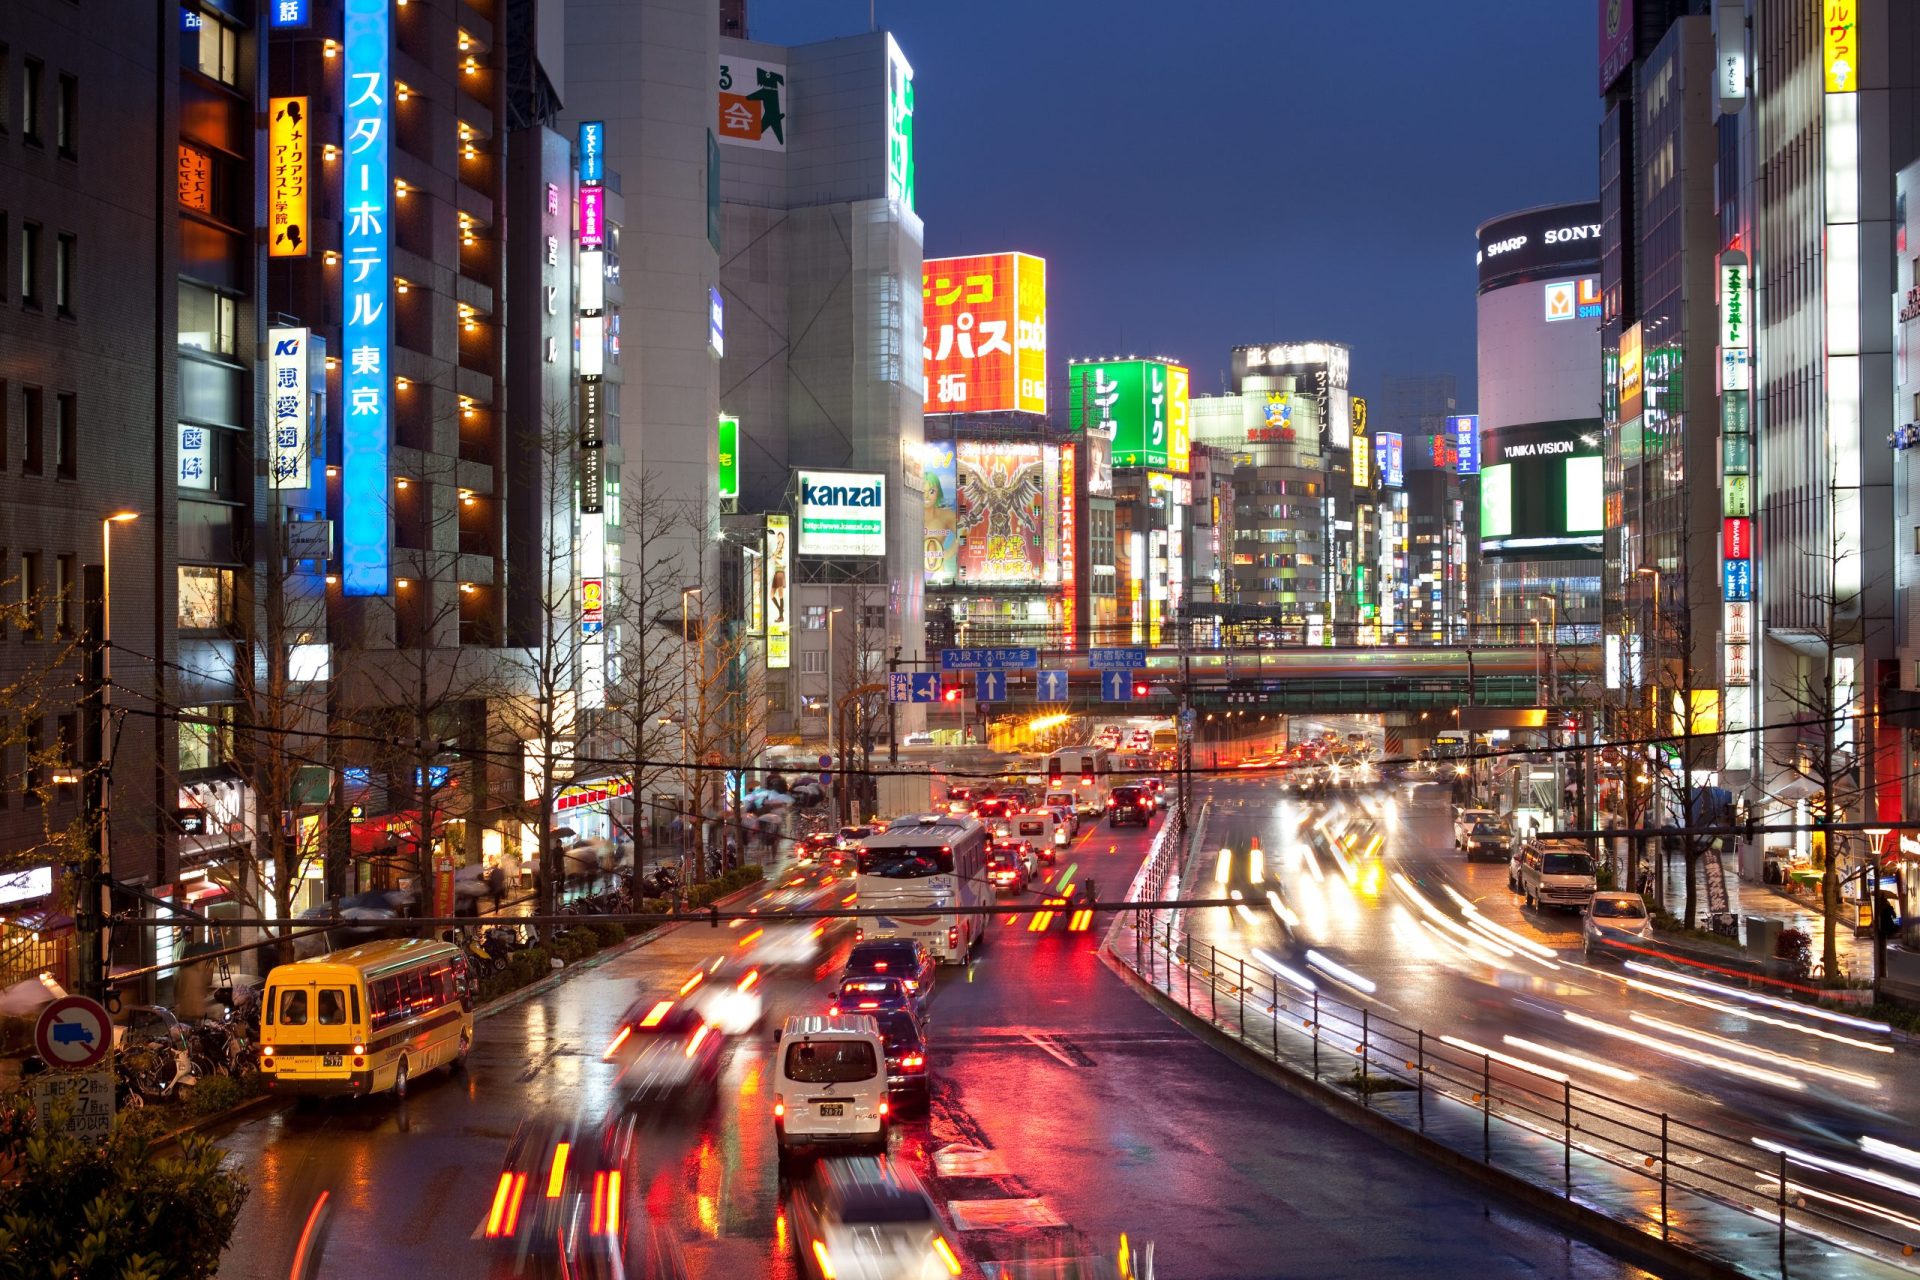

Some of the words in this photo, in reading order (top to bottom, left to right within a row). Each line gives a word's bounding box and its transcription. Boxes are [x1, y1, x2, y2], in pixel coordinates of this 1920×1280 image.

[1544, 224, 1602, 244] SONY
[1487, 236, 1527, 257] SHARP
[1727, 268, 1742, 342] スキンサポート
[1151, 367, 1164, 446] レイク
[1173, 372, 1187, 455] アコム
[1503, 443, 1536, 458] YUNIKA
[1537, 441, 1574, 455] VISION
[802, 480, 882, 508] kanzai
[949, 652, 983, 661] 九段下
